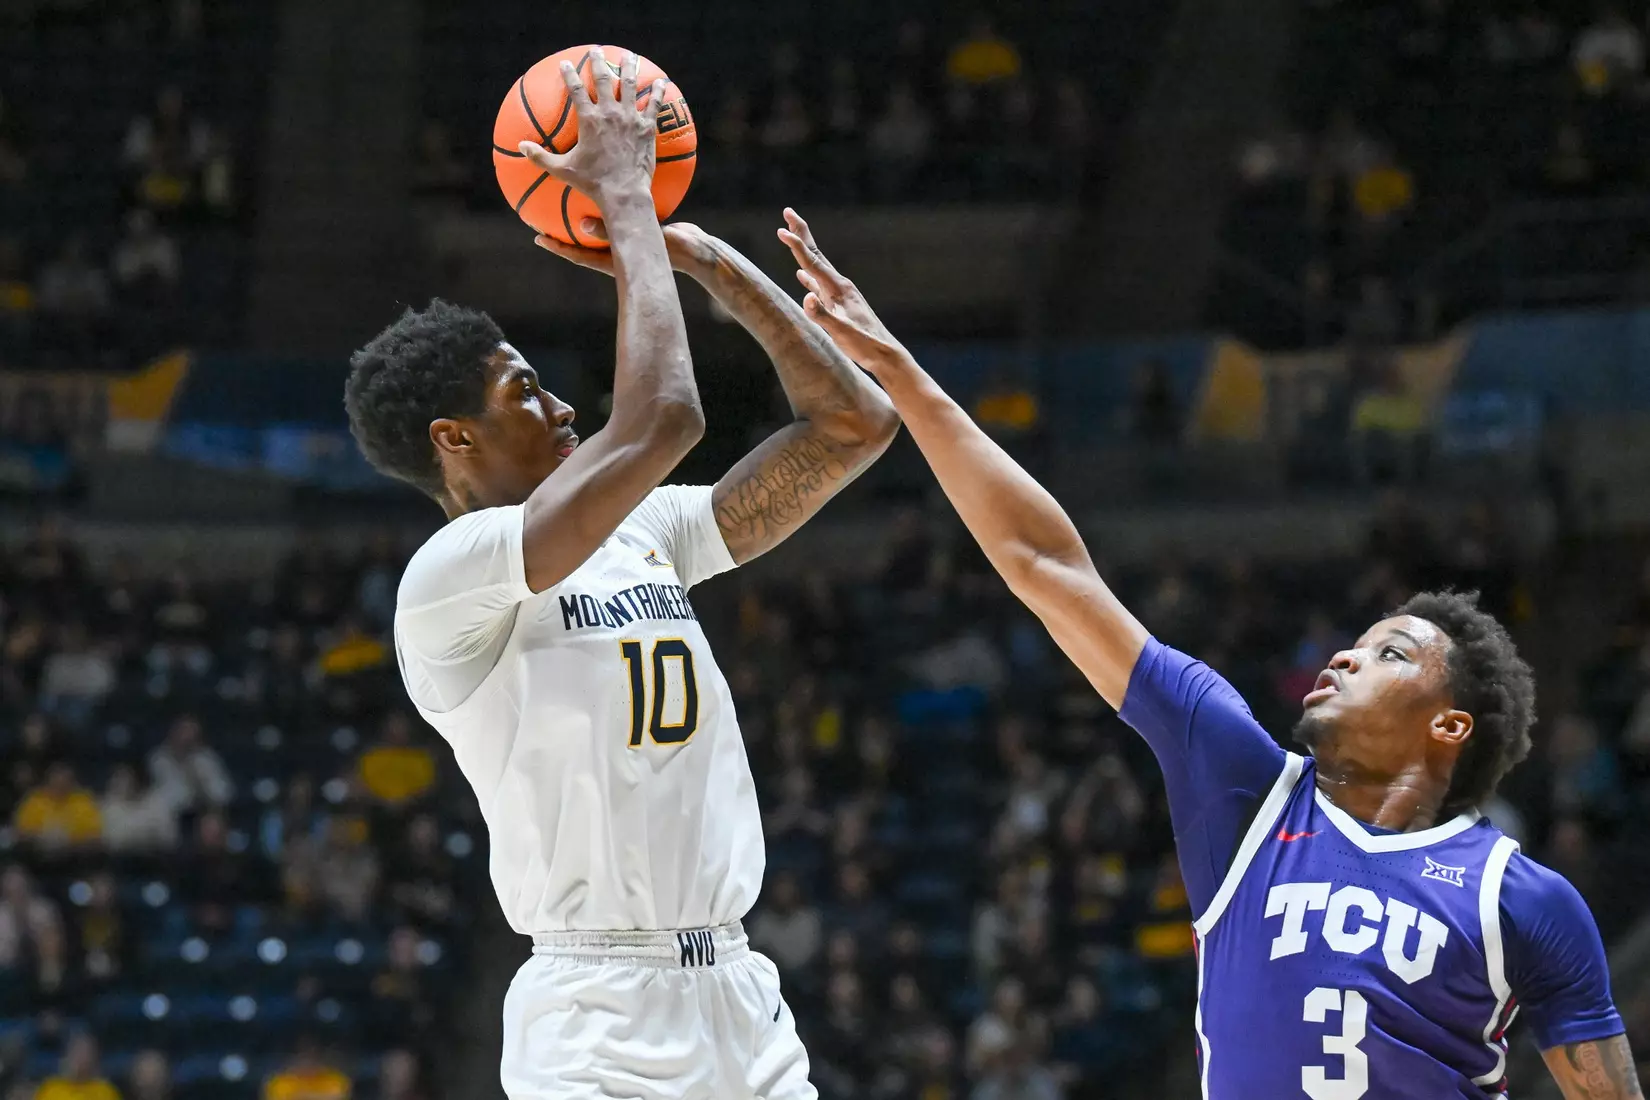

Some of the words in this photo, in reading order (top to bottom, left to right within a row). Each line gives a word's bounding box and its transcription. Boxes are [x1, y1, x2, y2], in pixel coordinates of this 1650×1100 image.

[619, 637, 698, 748] 10
[677, 931, 715, 967] WVU
[1264, 882, 1449, 985] TCU
[1301, 987, 1369, 1100] 3
